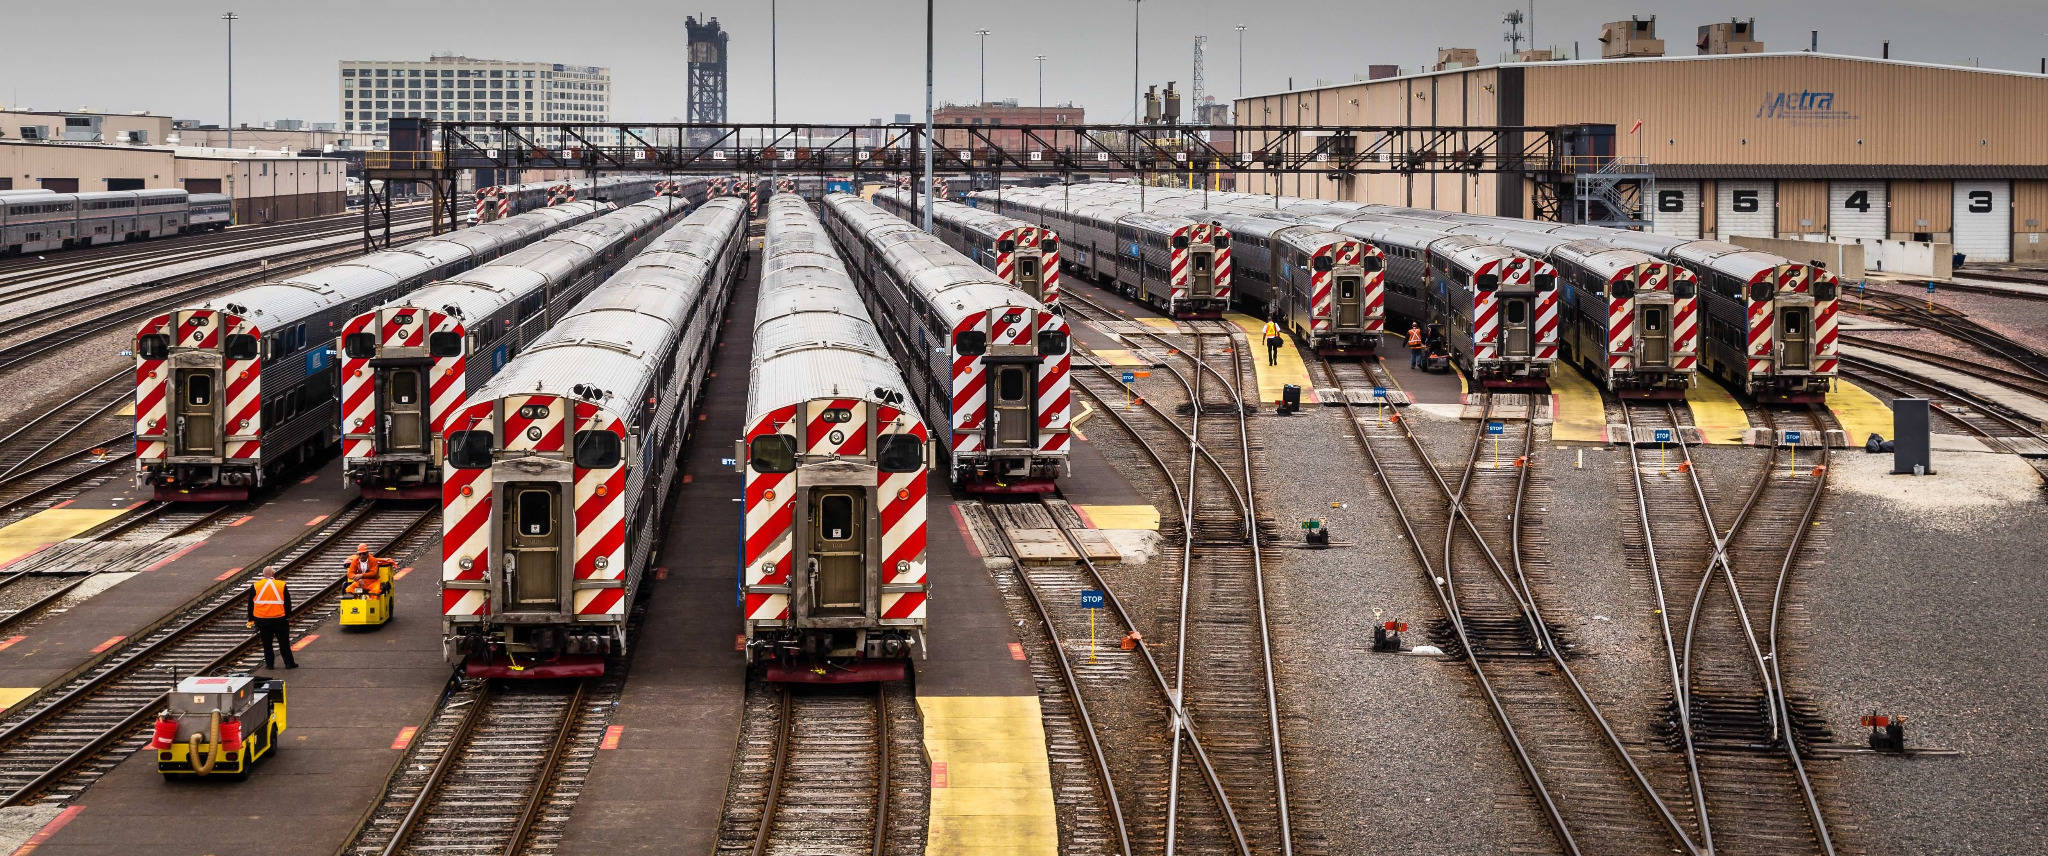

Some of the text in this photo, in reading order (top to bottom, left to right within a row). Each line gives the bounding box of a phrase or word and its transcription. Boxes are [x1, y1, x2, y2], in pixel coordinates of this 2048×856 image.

[1756, 89, 1834, 118] Metra
[1658, 190, 1684, 213] 6
[1732, 190, 1759, 213] 5
[1845, 190, 1871, 213] 4
[1968, 190, 1993, 213] 3
[1082, 595, 1103, 603] STOP
